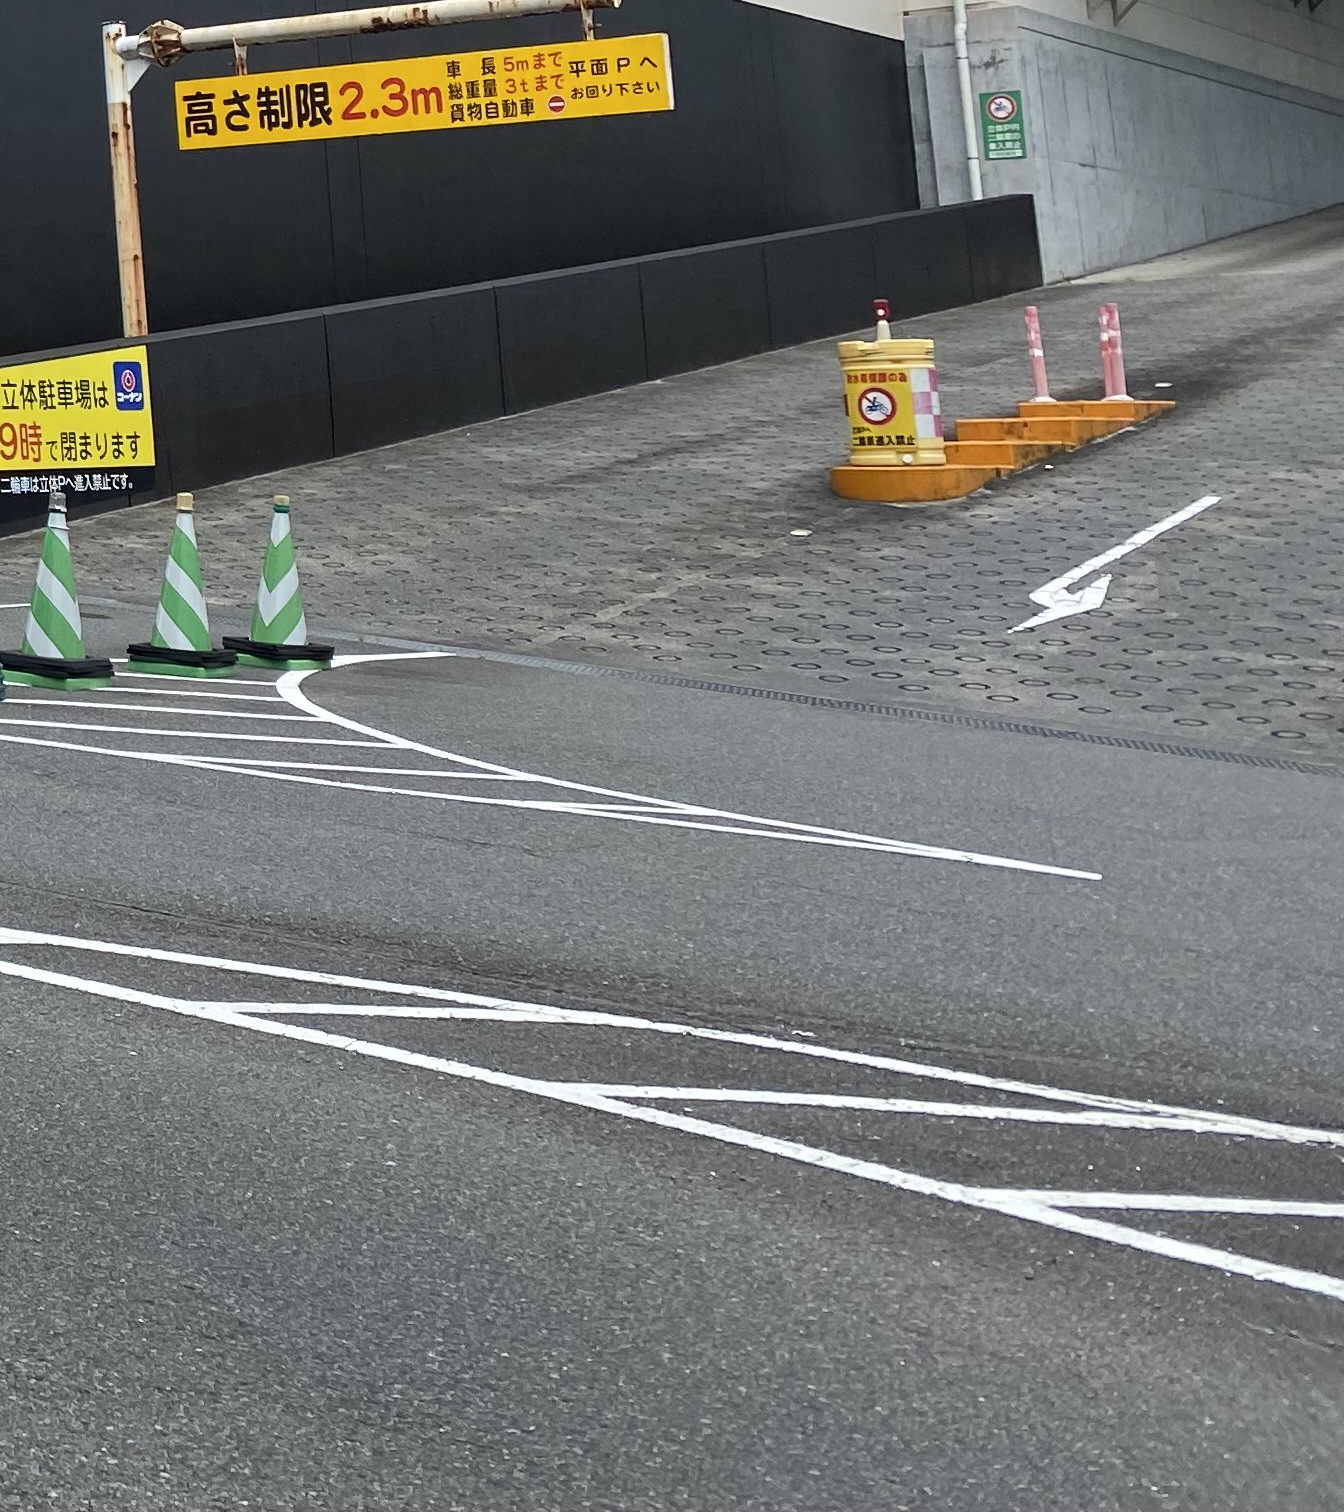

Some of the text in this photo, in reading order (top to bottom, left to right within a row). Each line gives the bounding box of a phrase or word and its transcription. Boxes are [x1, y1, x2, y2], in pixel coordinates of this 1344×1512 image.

[570, 81, 661, 101] お回り下さい
[450, 97, 535, 123] 貨物自動車
[1, 379, 109, 410] 立体駐車場は
[117, 392, 143, 402] コーナン
[1, 473, 133, 494] 二輪車は立体Pへ進入禁止です。
